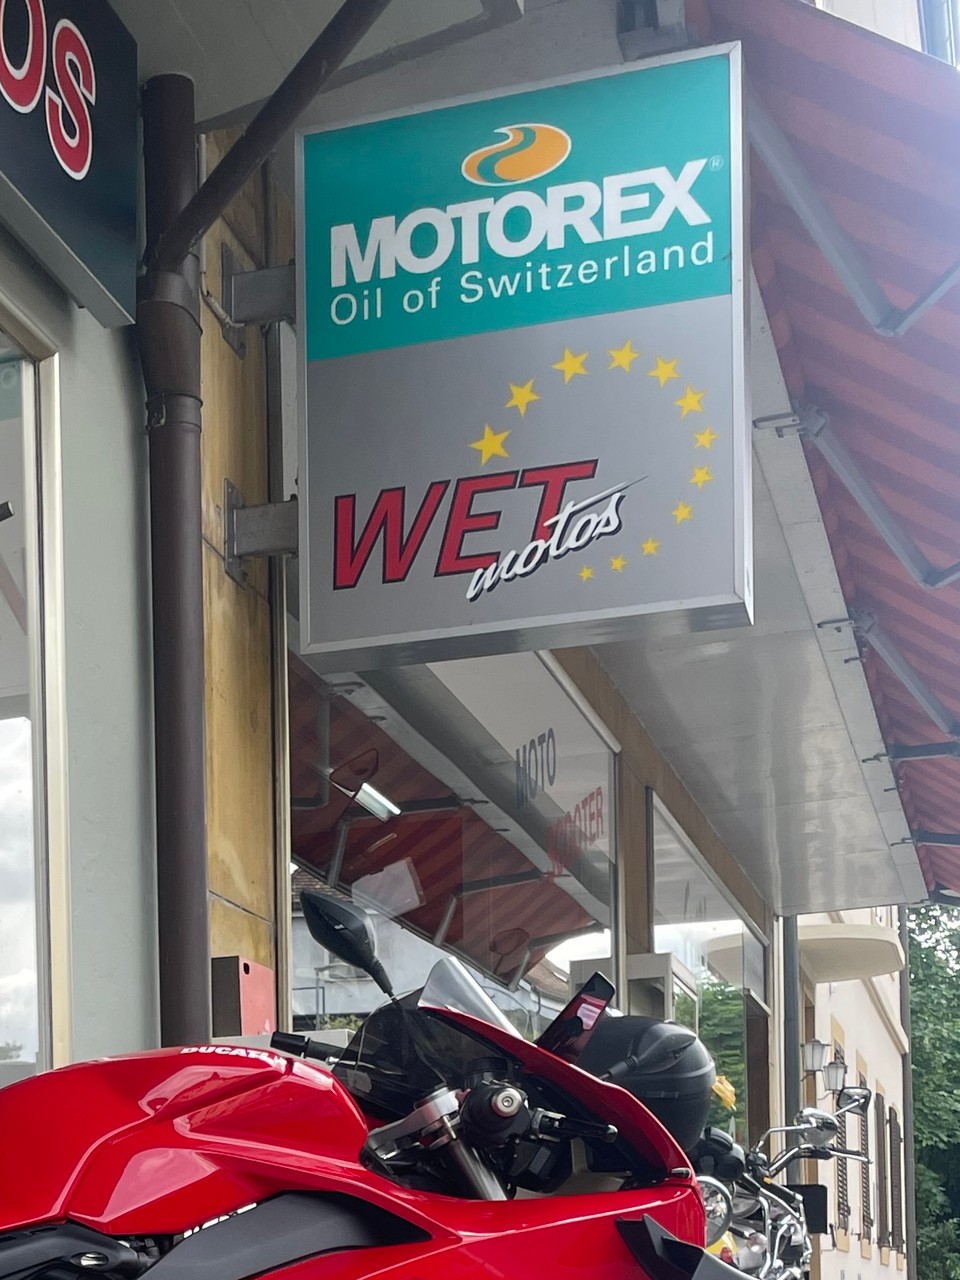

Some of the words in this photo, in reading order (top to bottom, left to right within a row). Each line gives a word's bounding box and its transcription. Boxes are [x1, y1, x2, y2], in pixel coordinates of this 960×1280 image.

[330, 158, 713, 289] MOTOREX
[330, 287, 382, 326] Oil
[402, 276, 442, 314] of
[460, 232, 714, 304] Switzerland
[333, 458, 600, 591] WET
[465, 475, 648, 602] motos
[515, 727, 557, 811] MOTO
